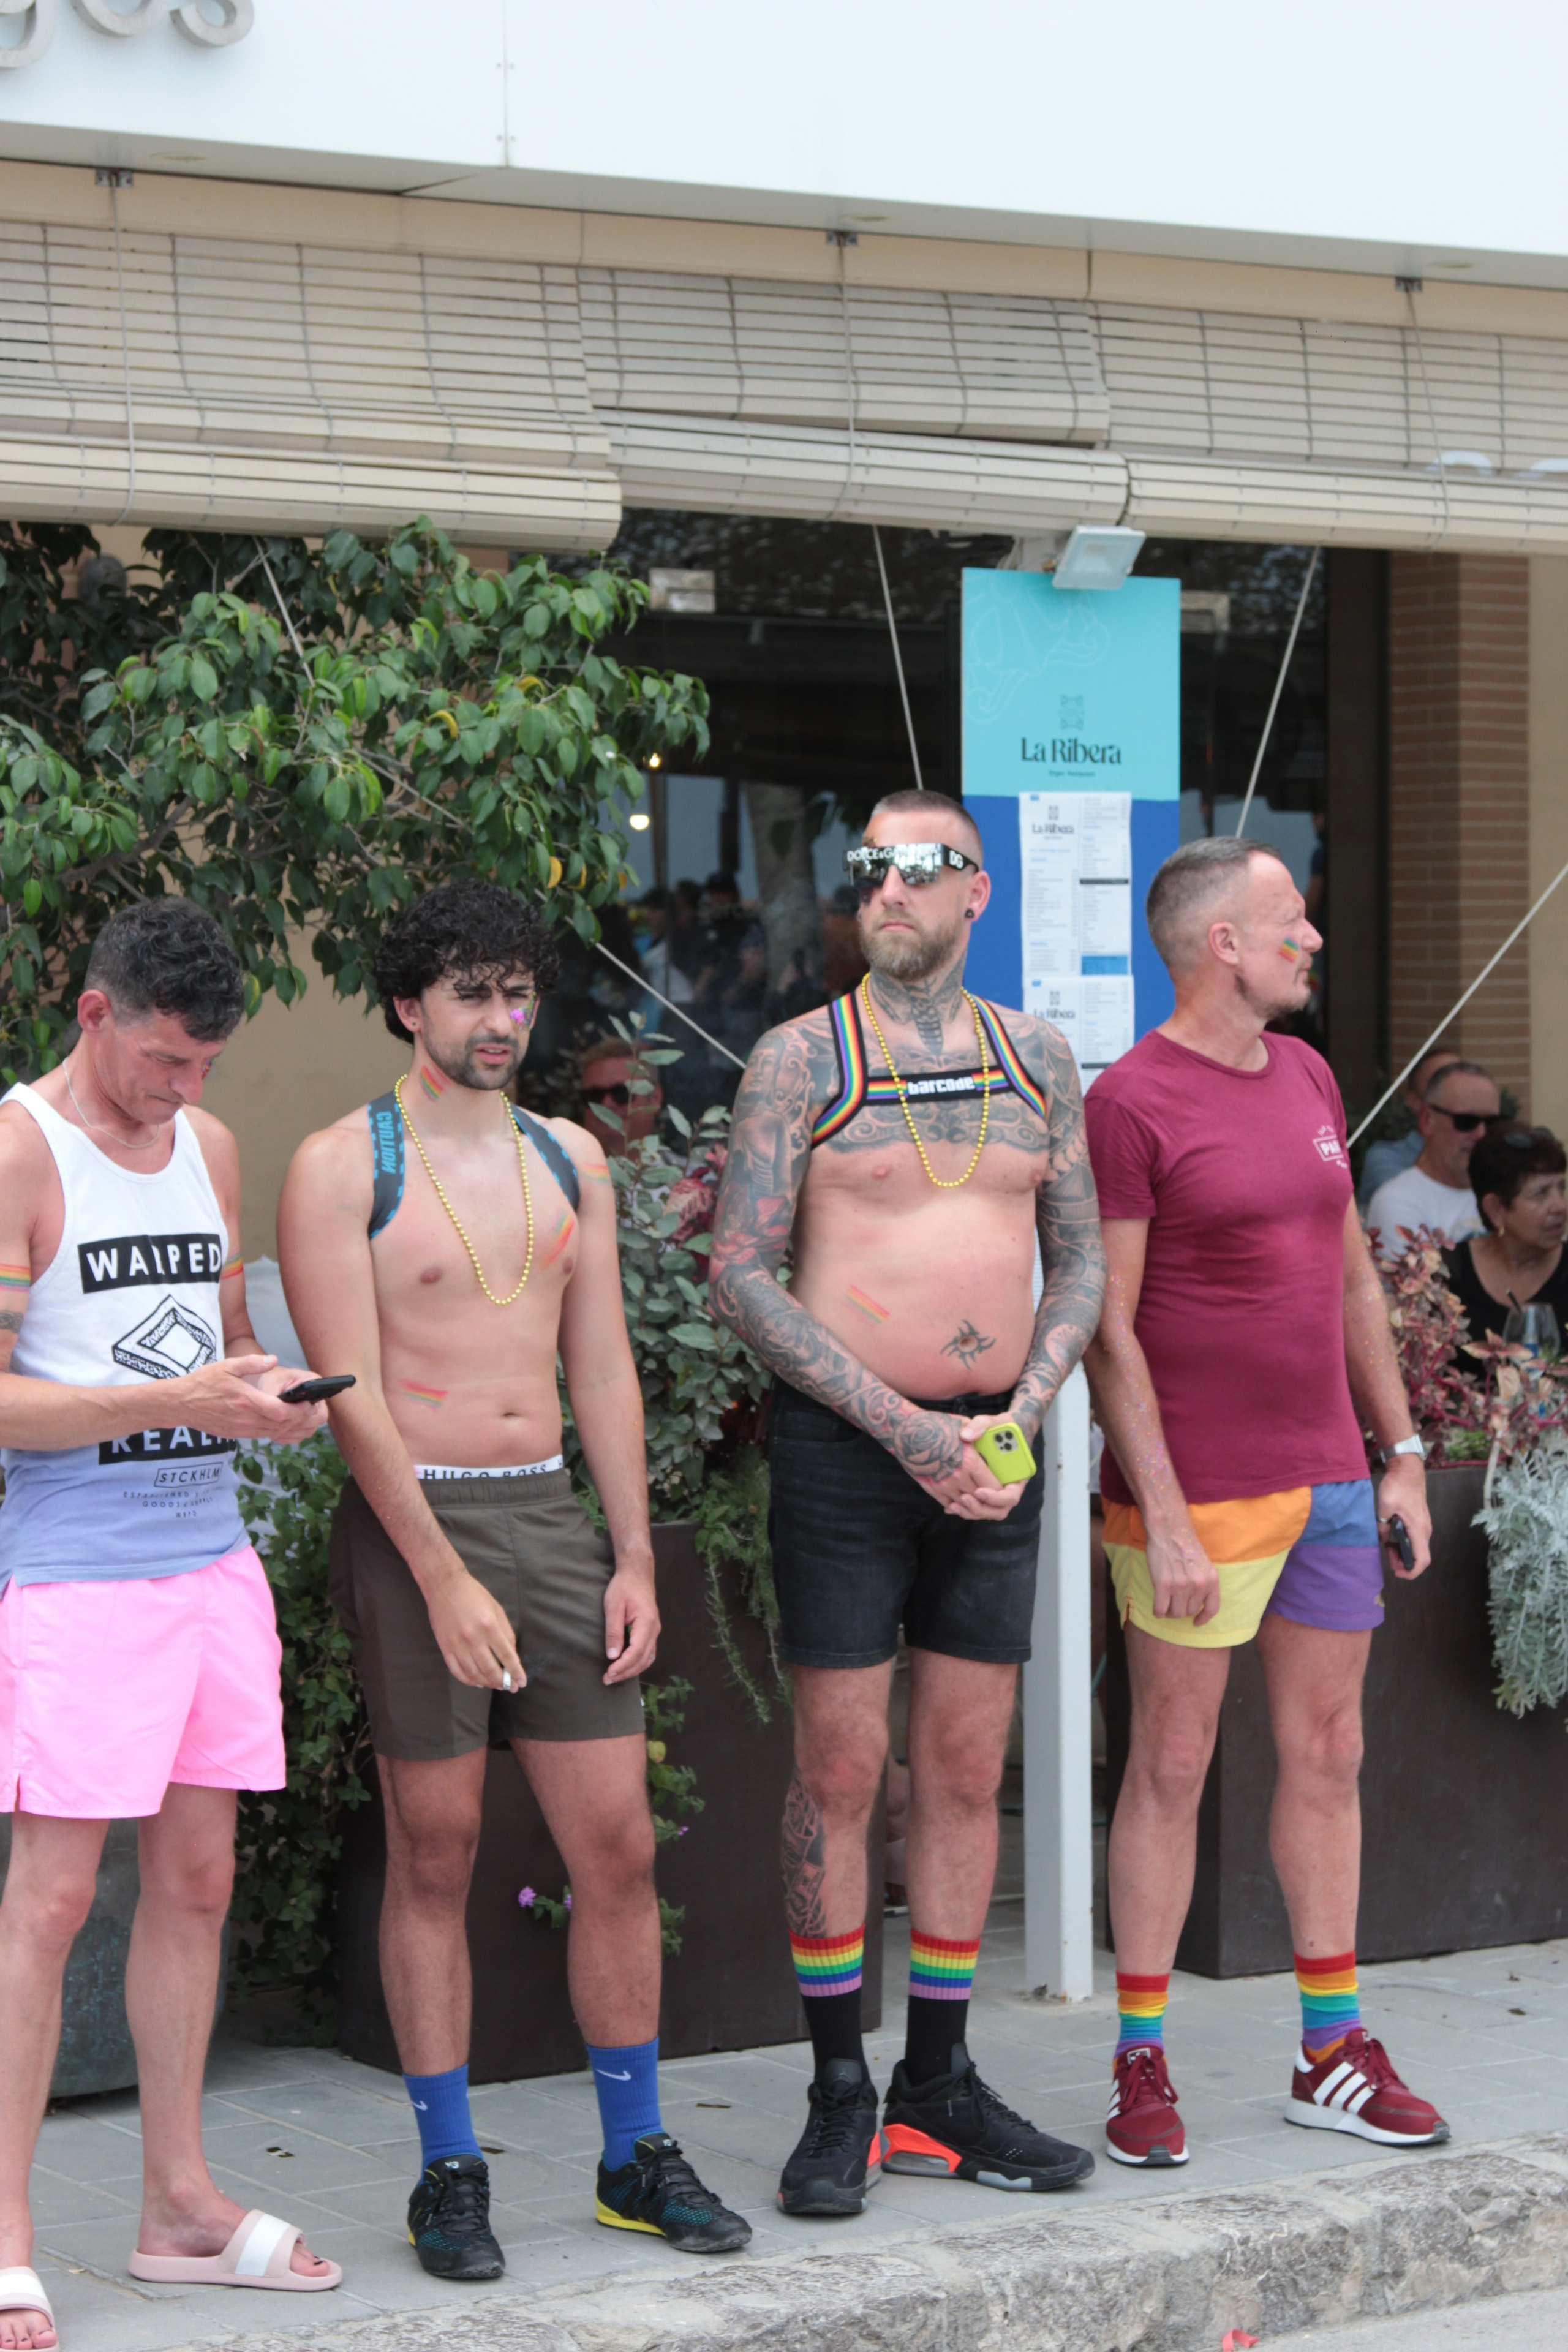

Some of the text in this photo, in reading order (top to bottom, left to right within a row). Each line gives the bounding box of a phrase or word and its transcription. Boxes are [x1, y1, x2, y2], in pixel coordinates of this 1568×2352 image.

[1021, 737, 1121, 765] La Ribera
[949, 850, 964, 869] DG
[907, 1076, 976, 1096] barcode
[159, 1467, 220, 1483] STCKHLM
